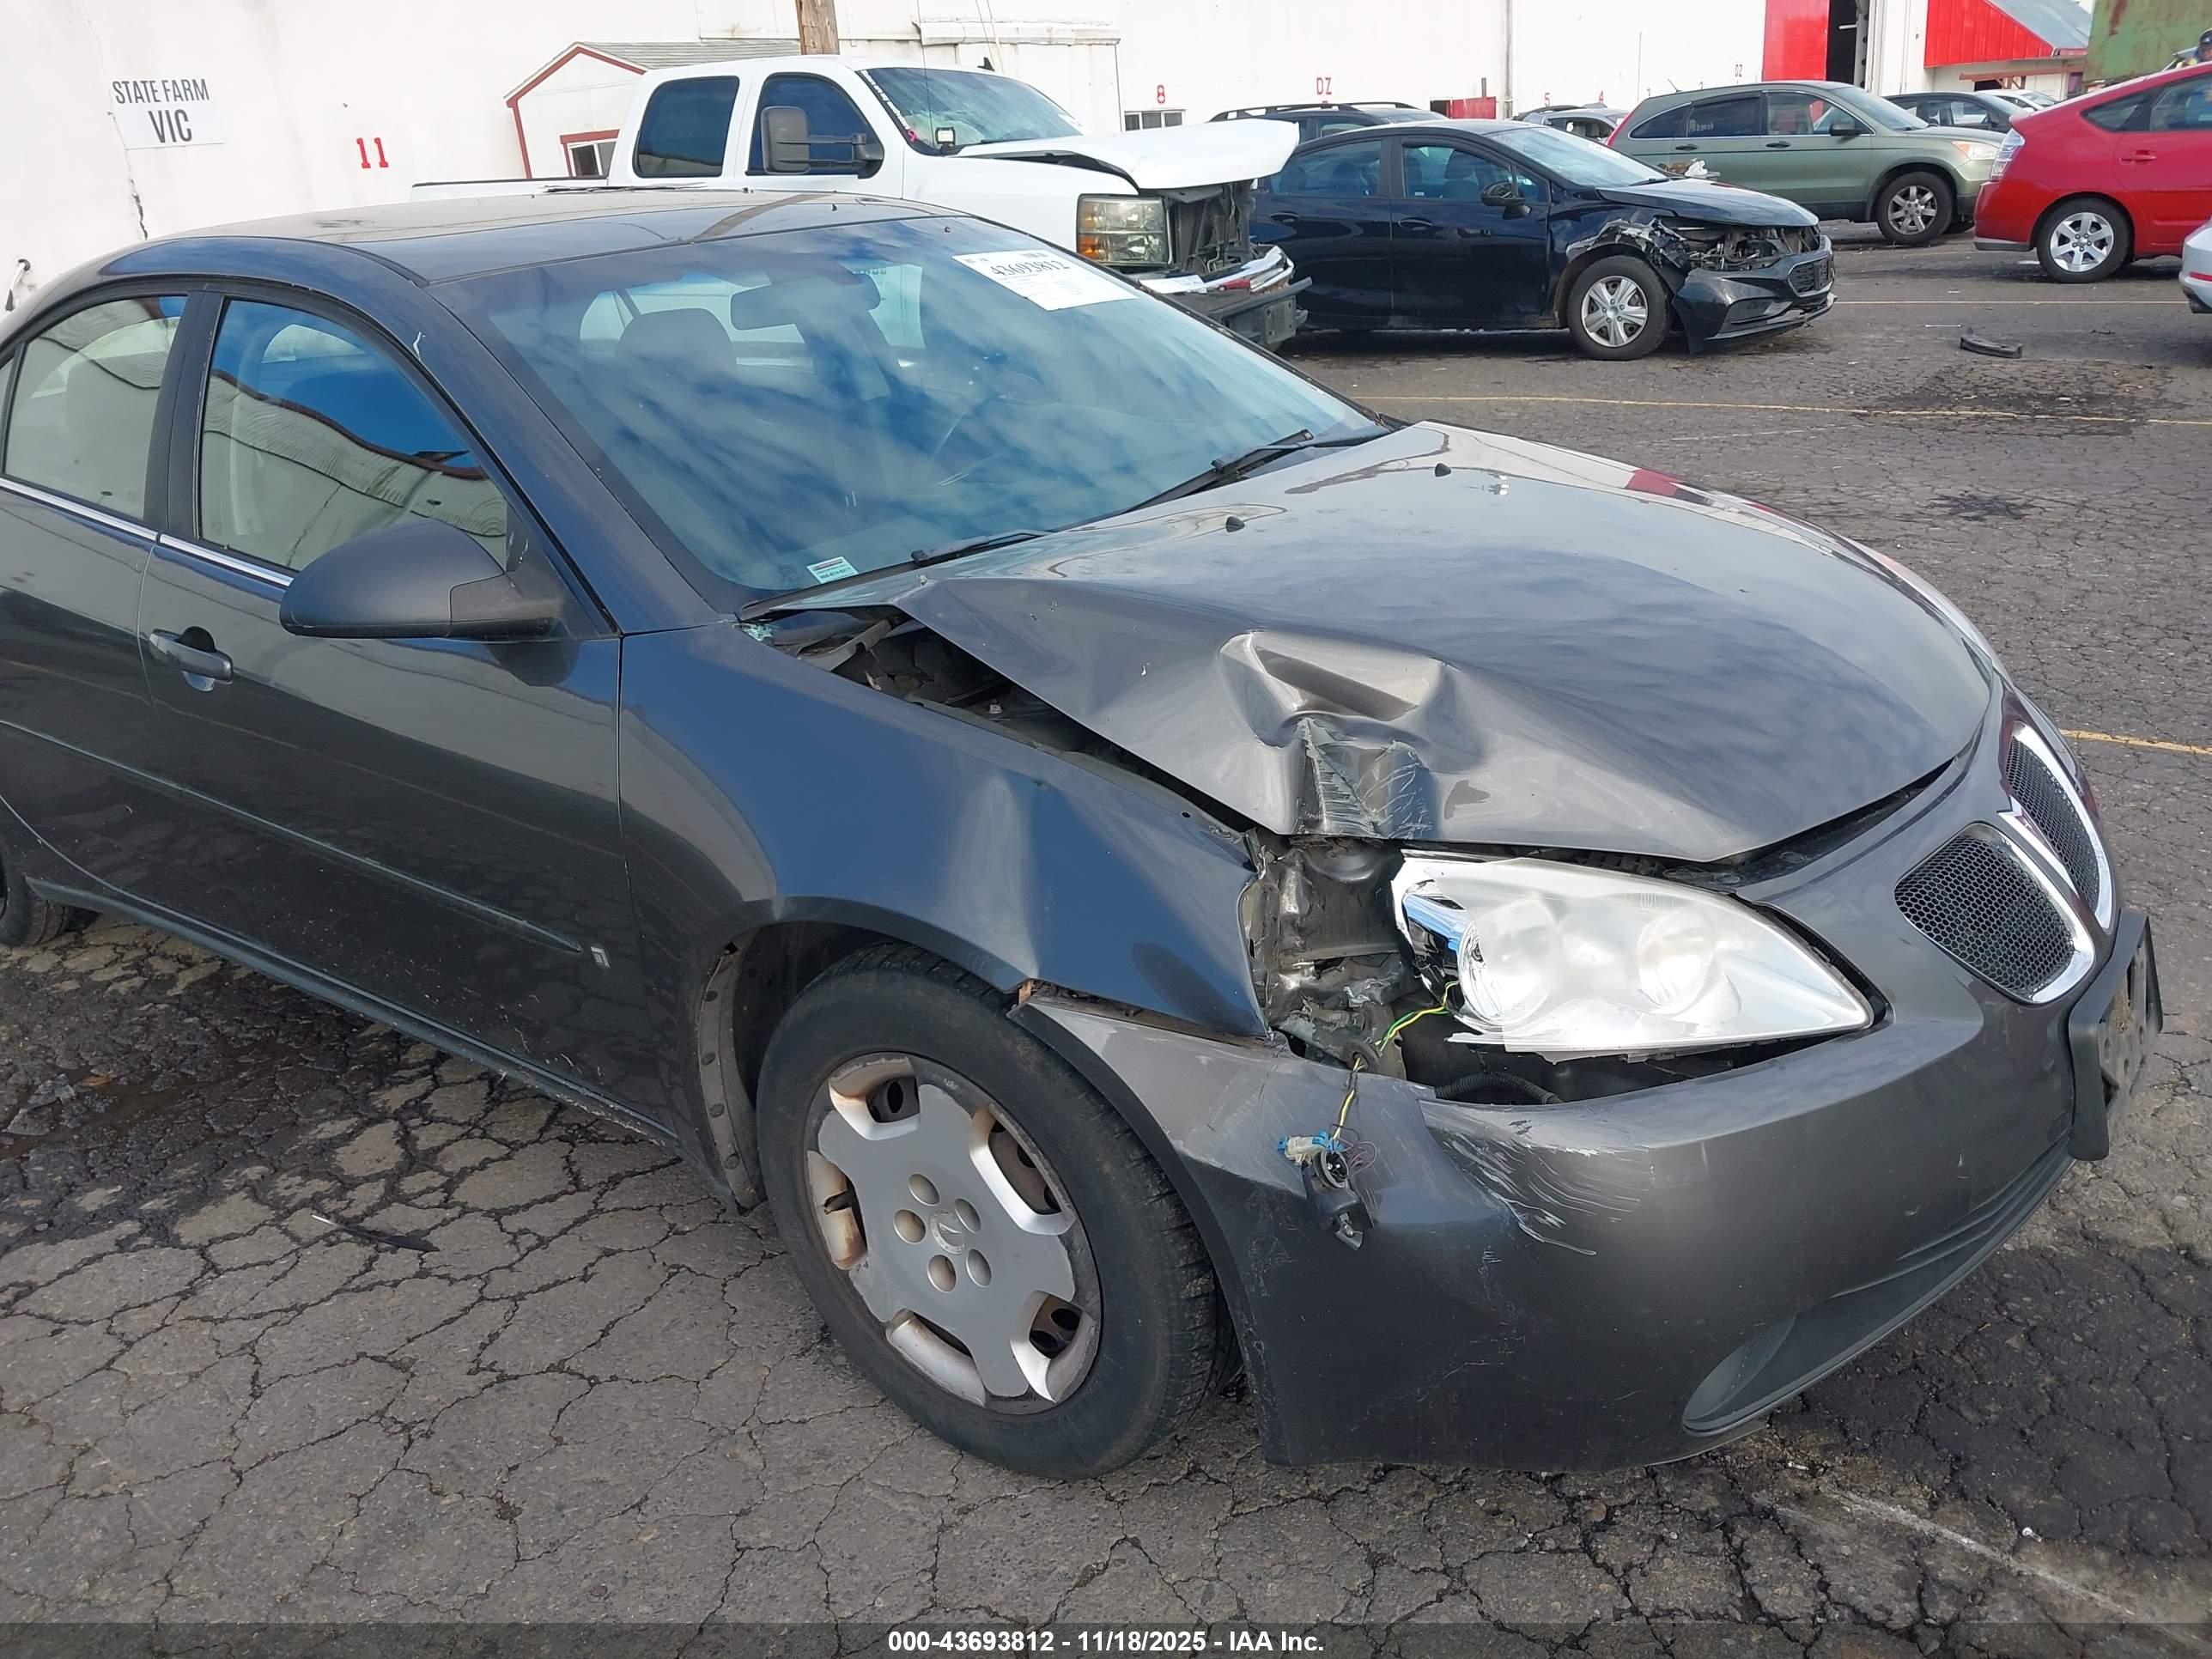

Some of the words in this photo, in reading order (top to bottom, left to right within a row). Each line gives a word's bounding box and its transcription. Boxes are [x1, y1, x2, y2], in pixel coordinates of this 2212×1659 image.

[112, 80, 161, 104] STATE
[161, 78, 210, 102] FARM
[1157, 84, 1166, 104] 8
[1316, 77, 1332, 95] DZ
[1545, 92, 1550, 106] 5
[148, 108, 192, 143] VIC
[356, 137, 389, 169] 11
[990, 259, 1070, 276] 43693812
